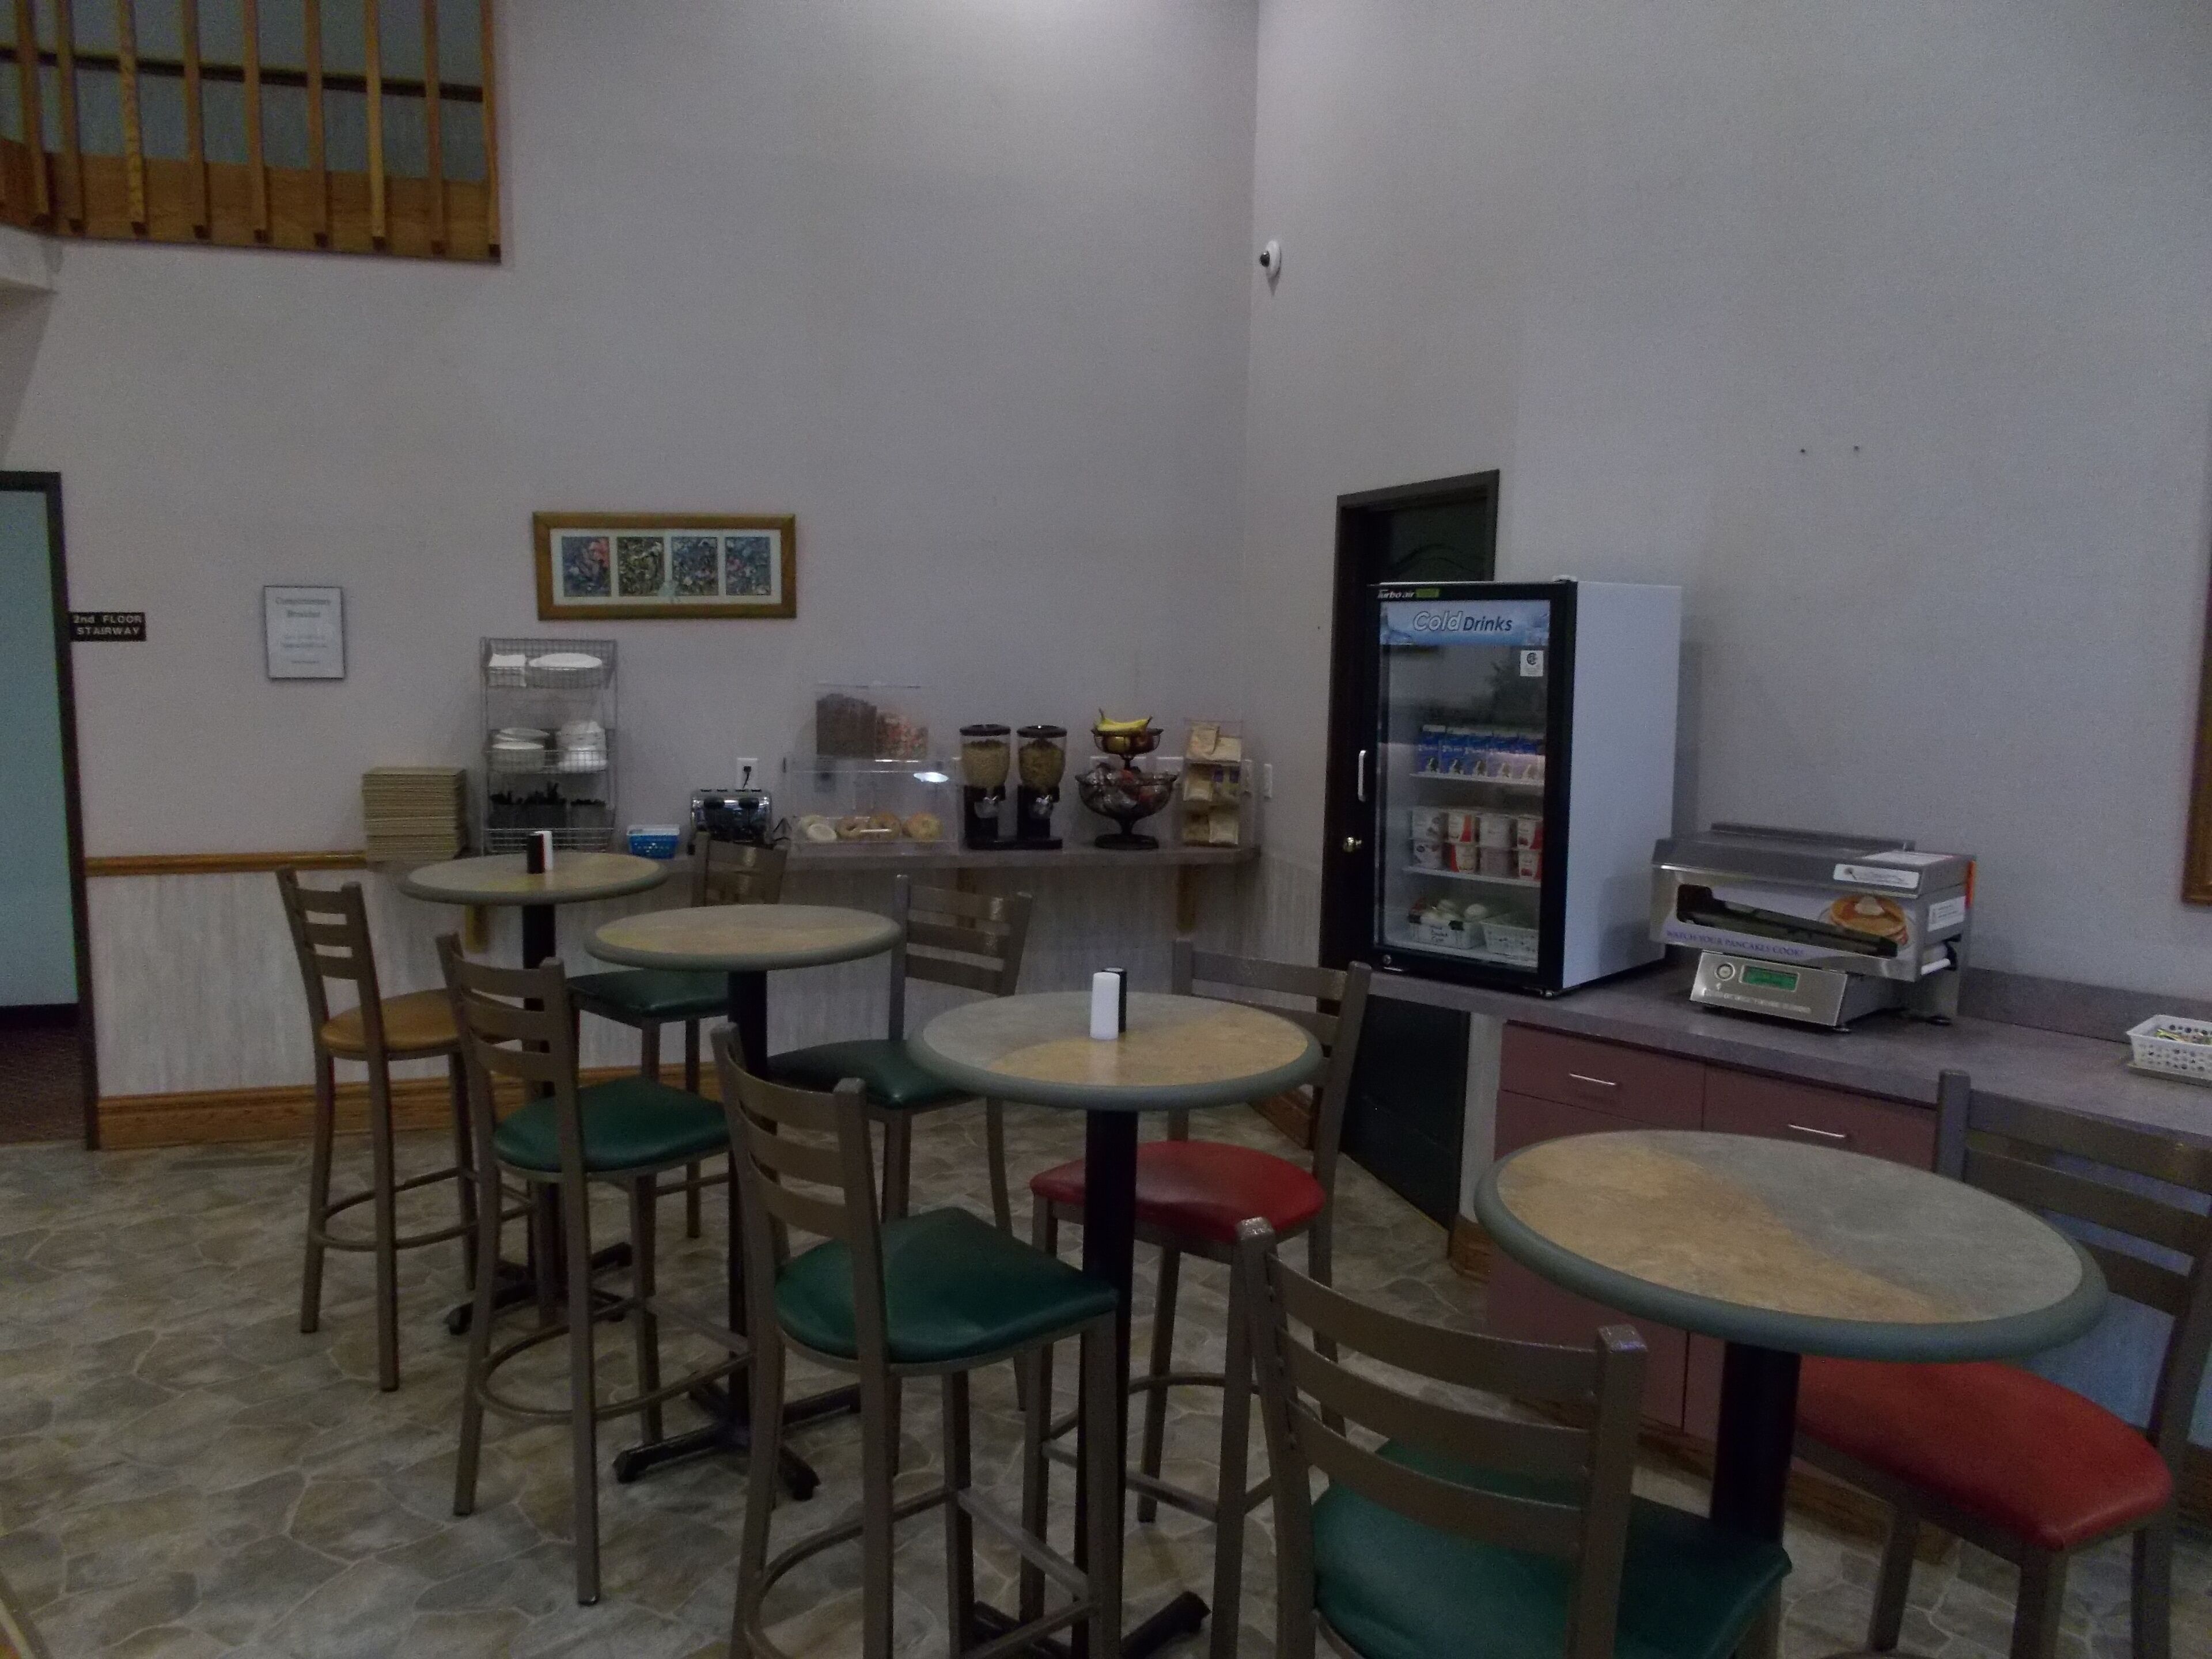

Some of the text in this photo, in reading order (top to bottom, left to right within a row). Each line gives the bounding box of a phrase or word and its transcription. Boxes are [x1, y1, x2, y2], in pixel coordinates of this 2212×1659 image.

[73, 615, 142, 623] 2nd FLOOR
[1413, 611, 1512, 631] Cold Drinks
[77, 627, 139, 635] STAIRWAY
[1666, 930, 1697, 941] WATCH
[1699, 934, 1723, 945] YOUR
[1725, 939, 1770, 953] PANCAKES
